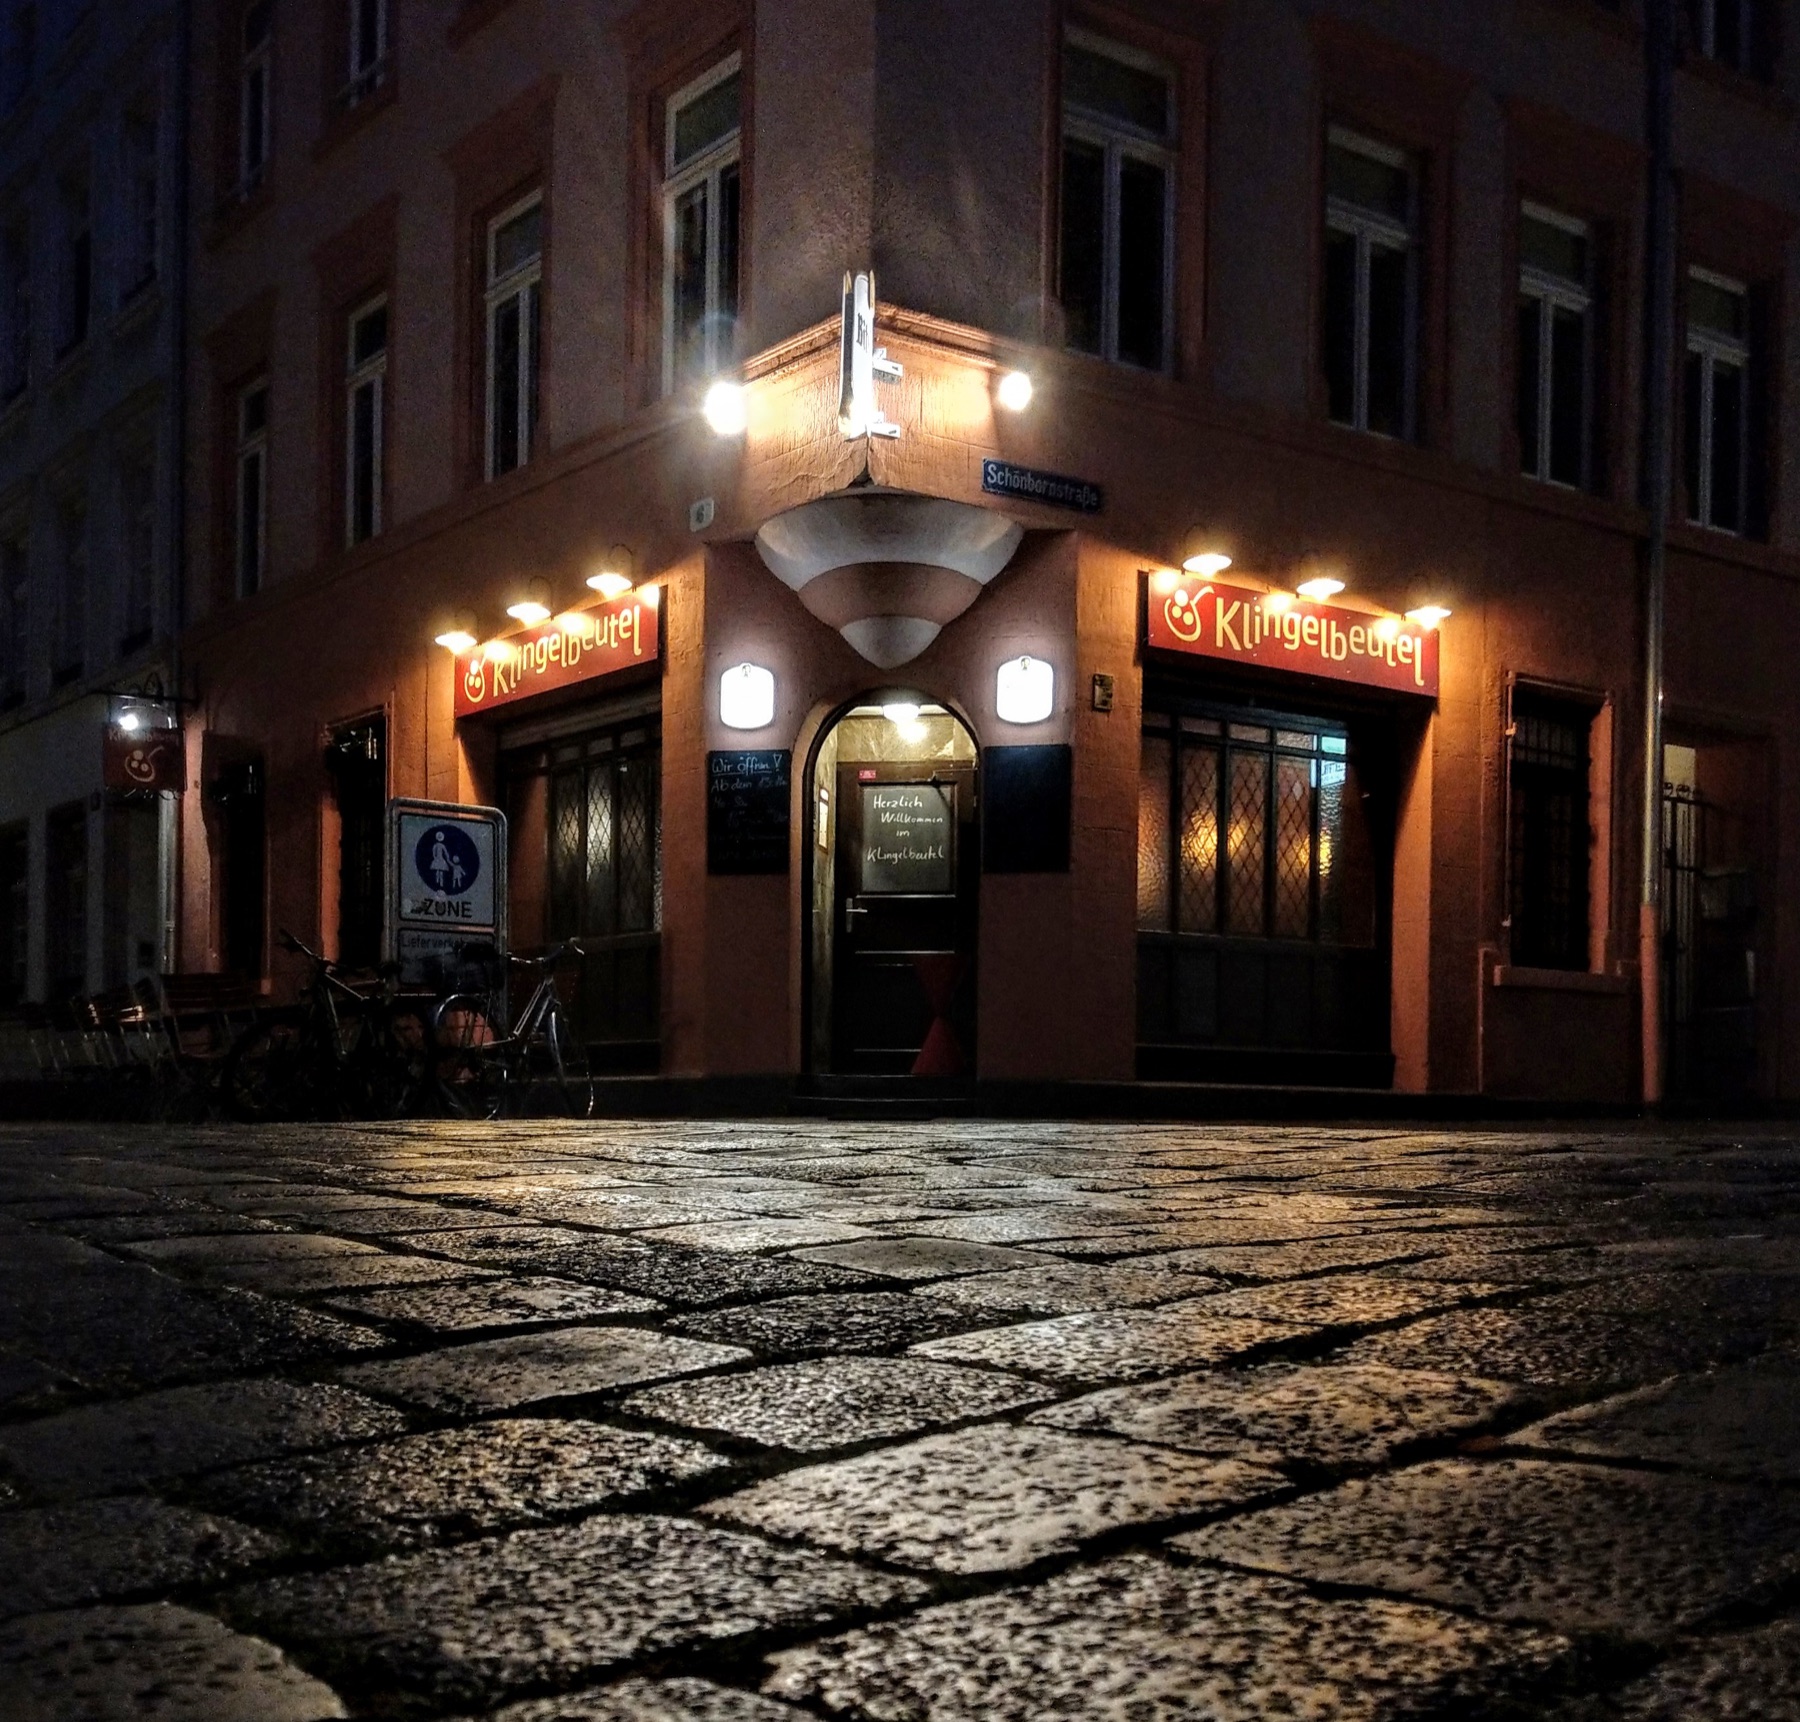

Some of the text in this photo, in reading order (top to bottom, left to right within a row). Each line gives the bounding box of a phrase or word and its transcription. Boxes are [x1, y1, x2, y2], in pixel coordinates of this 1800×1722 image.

[987, 463, 1099, 508] Schönbornstraße
[1215, 596, 1425, 687] Klingelbeutel
[493, 604, 642, 698] Klingelbeutel
[711, 757, 734, 774] Wir
[711, 778, 729, 794] Ab
[872, 793, 923, 810] Herzlich
[880, 811, 943, 824] Willkommen
[895, 829, 911, 838] im
[867, 845, 945, 865] Klingelbeutel
